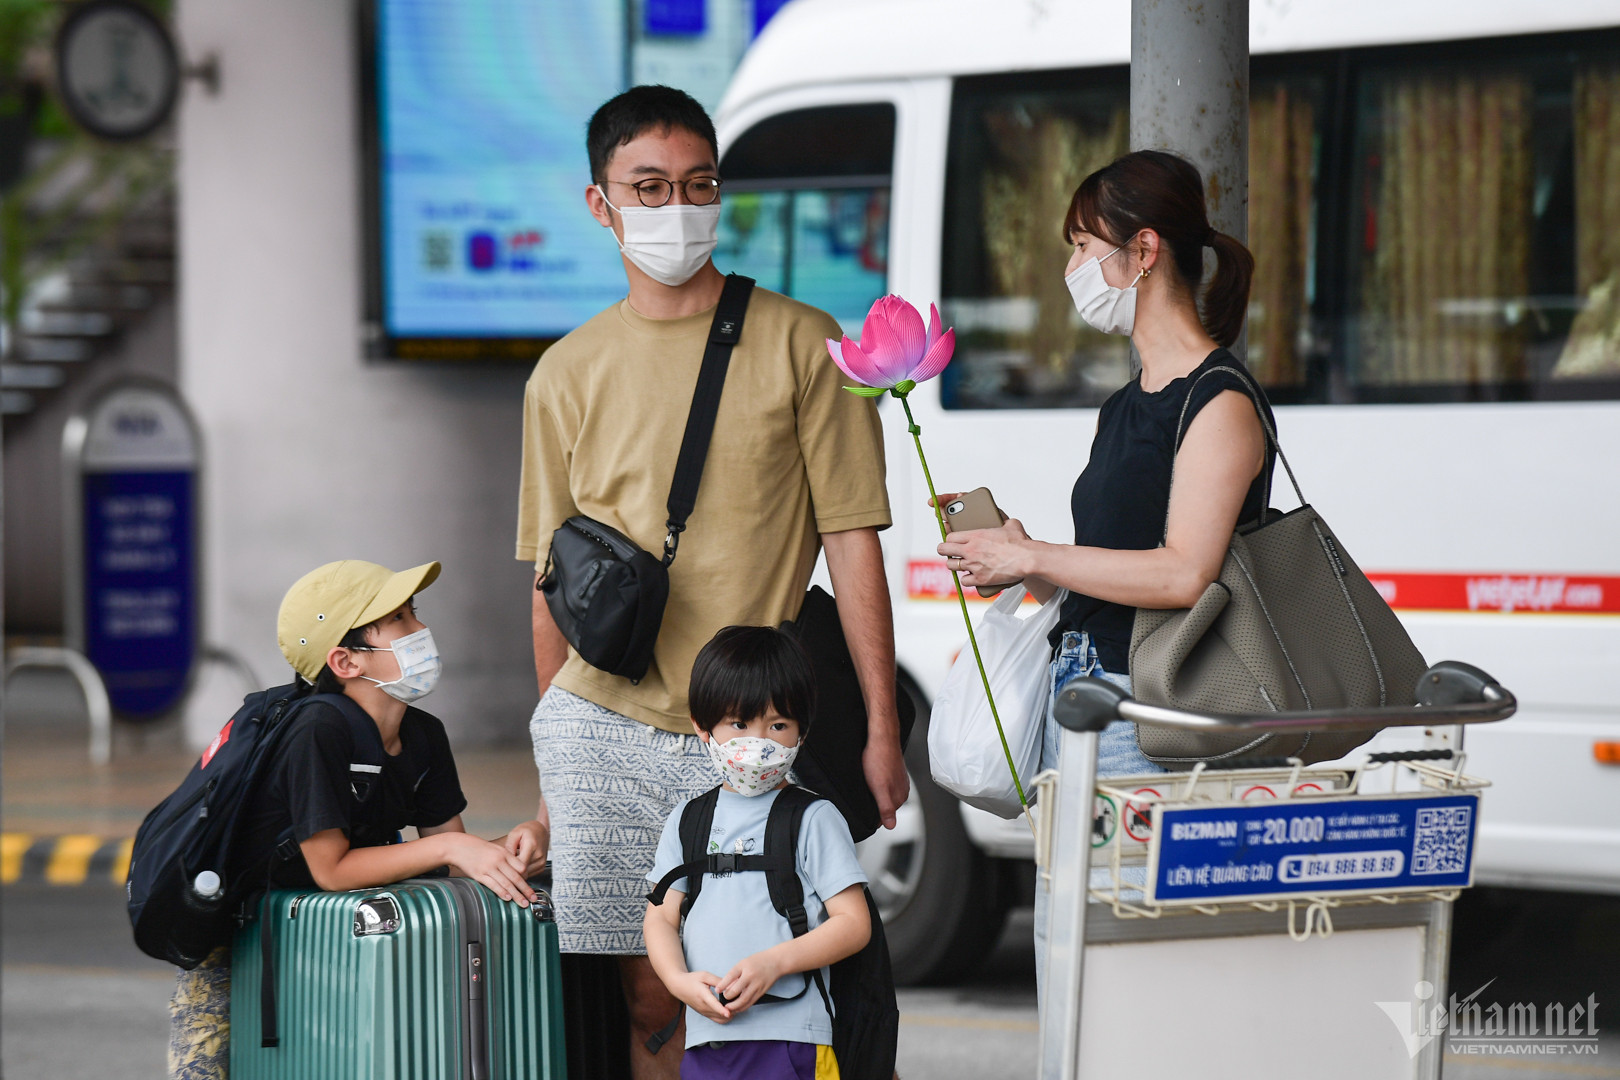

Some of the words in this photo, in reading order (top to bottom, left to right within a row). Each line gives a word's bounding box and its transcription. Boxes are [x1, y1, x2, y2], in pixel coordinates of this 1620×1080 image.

[1171, 821, 1238, 841] BIZMAN
[1263, 816, 1324, 845] 20.000
[1167, 865, 1194, 886] LIÊN
[1195, 863, 1211, 888] HỆ
[1212, 860, 1250, 885] QUẢNG
[1250, 861, 1273, 882] CÁO
